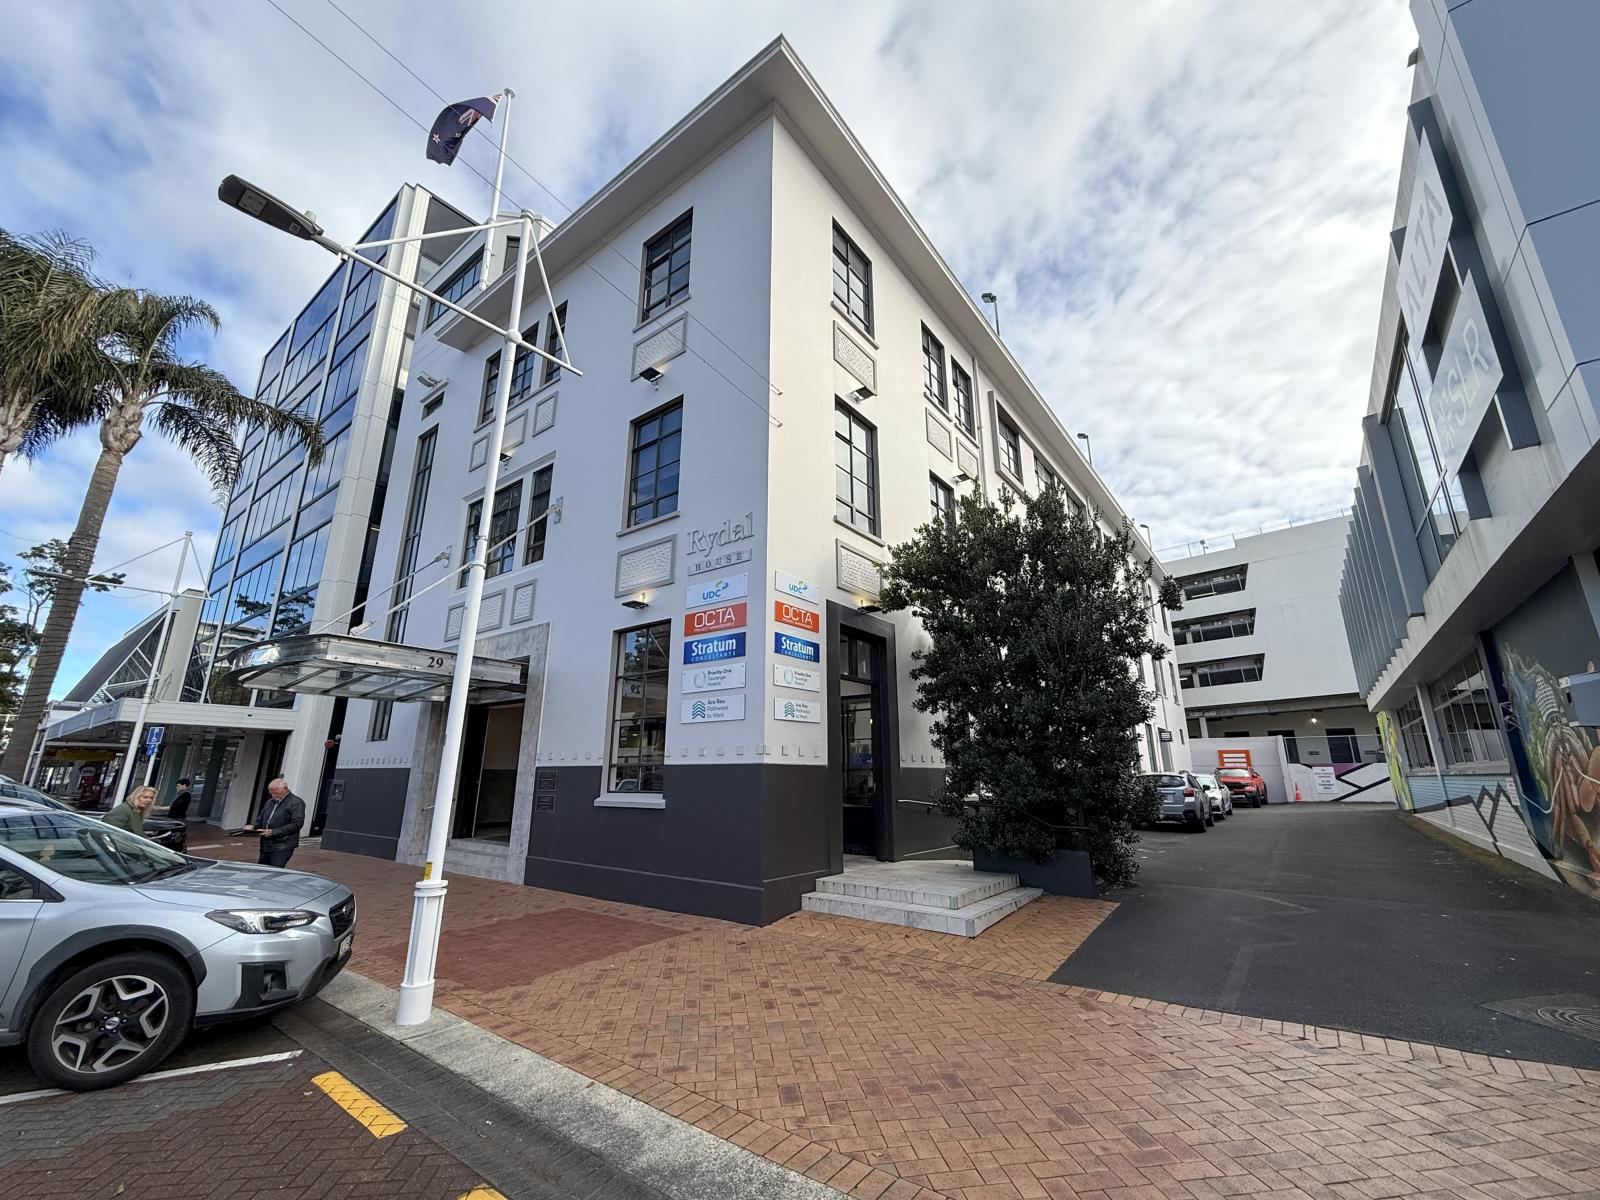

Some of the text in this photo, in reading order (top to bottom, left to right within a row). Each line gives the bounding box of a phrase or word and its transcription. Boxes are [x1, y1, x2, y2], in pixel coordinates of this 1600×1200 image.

[1405, 181, 1443, 333] ALTA
[1447, 318, 1489, 427] SLR
[686, 512, 755, 557] Rydal
[695, 552, 743, 571] HOUSE
[702, 589, 721, 600] UDC
[788, 584, 802, 594] UDC
[694, 607, 735, 628] OCTA
[782, 604, 813, 625] OCTA
[691, 638, 736, 656] Stratum
[781, 637, 814, 656] Stratum
[427, 656, 444, 669] 29
[691, 651, 736, 662] CONSULTANTS
